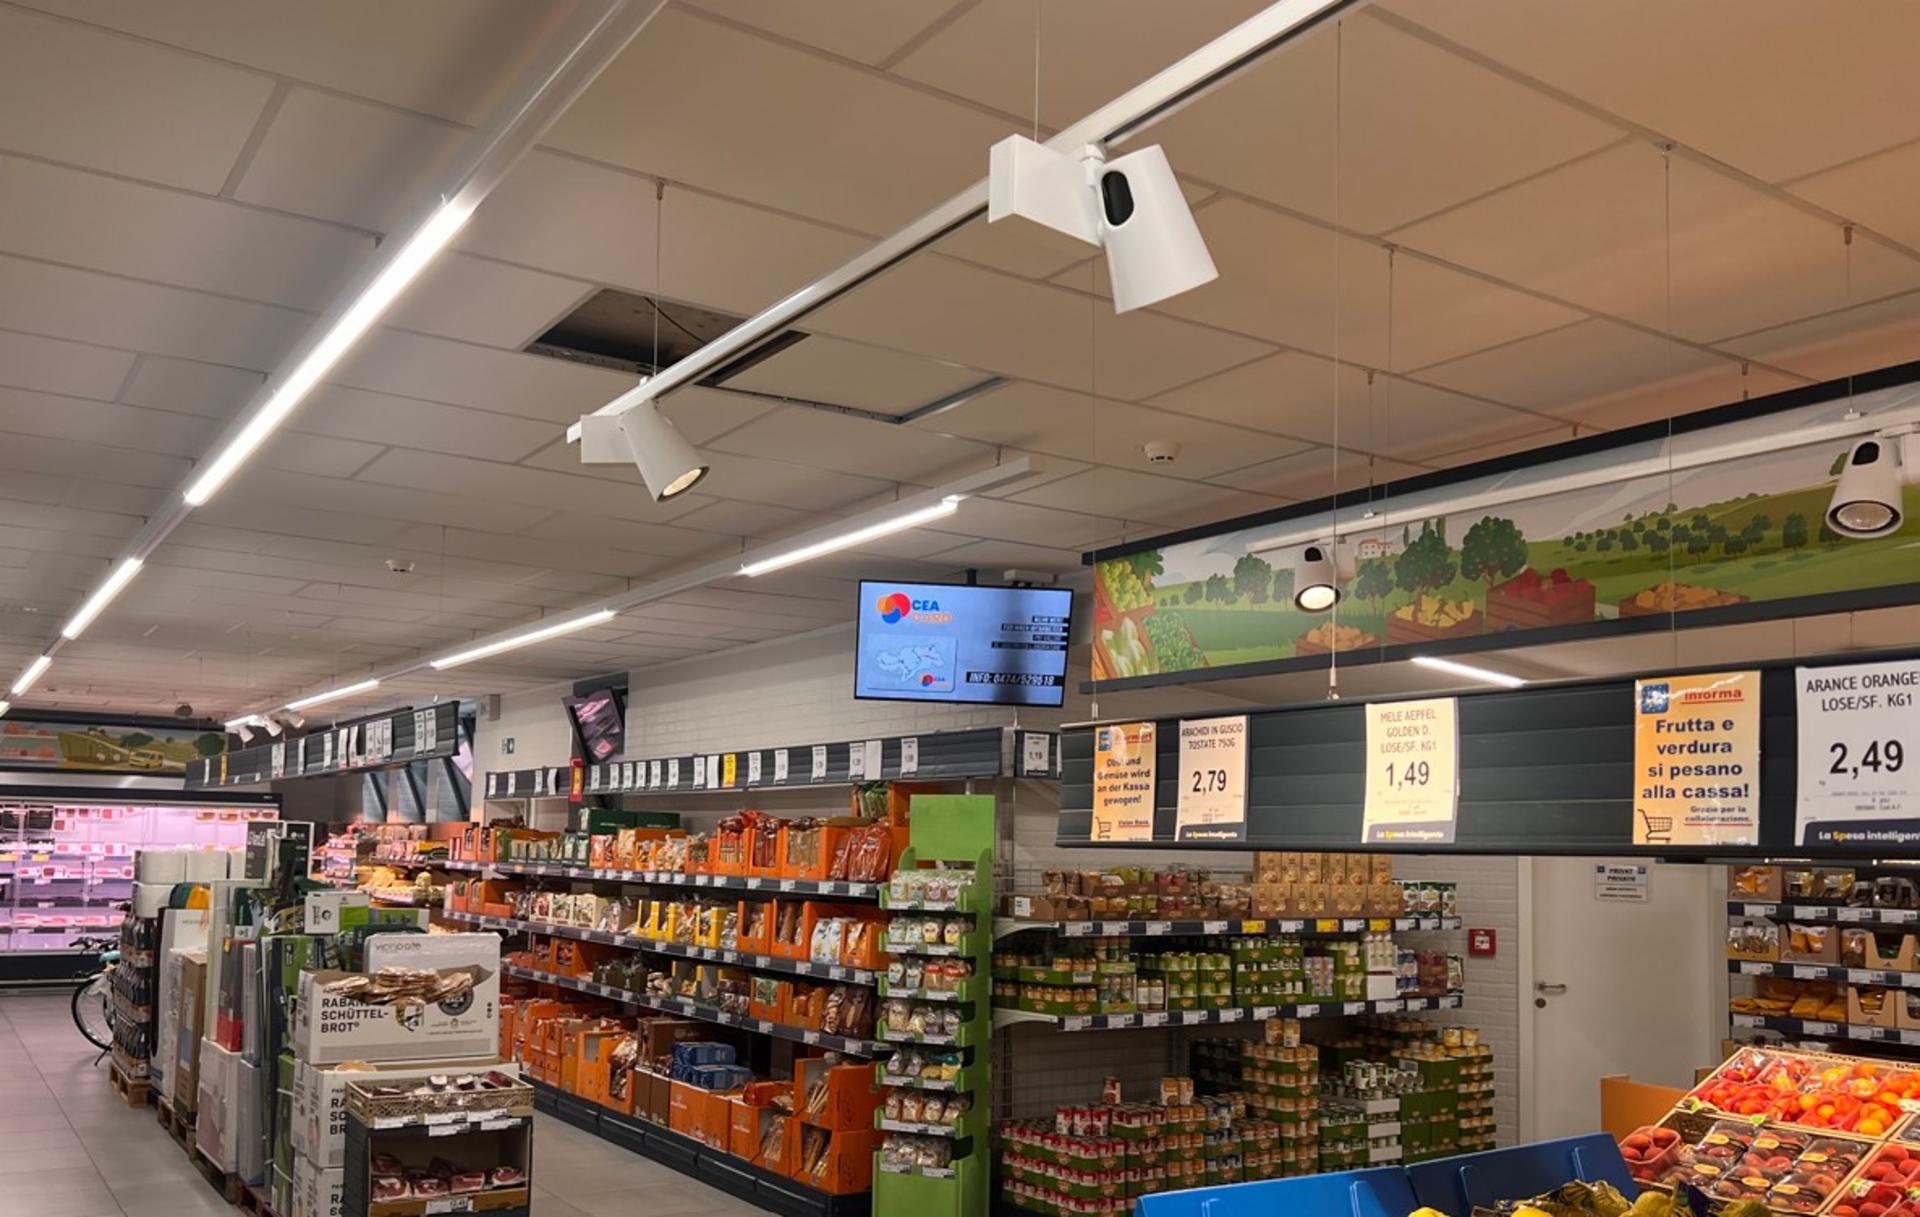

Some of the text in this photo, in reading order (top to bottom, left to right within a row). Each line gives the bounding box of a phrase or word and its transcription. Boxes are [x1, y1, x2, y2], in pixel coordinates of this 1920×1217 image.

[912, 600, 940, 611] CEA
[1806, 676, 1858, 693] ARANCE
[1821, 693, 1912, 712] LOSE/SF. KG1
[1380, 708, 1437, 723] MELE AEPFEL
[1386, 725, 1420, 738] GOLDEN
[1655, 718, 1734, 733] Frutta e
[1656, 739, 1733, 755] verdura
[1829, 739, 1904, 780] 2,49
[1130, 769, 1151, 778] wird
[1385, 760, 1430, 792] 1,49
[1648, 763, 1743, 780] si pesano
[1108, 784, 1121, 792] der
[1123, 782, 1150, 791] Kassa
[1192, 769, 1227, 796] 2,79
[1642, 783, 1749, 798] alla cassa!
[1819, 831, 1832, 840] La
[1832, 831, 1865, 842] Spesa
[321, 1007, 389, 1020] SCHÜTTEL-
